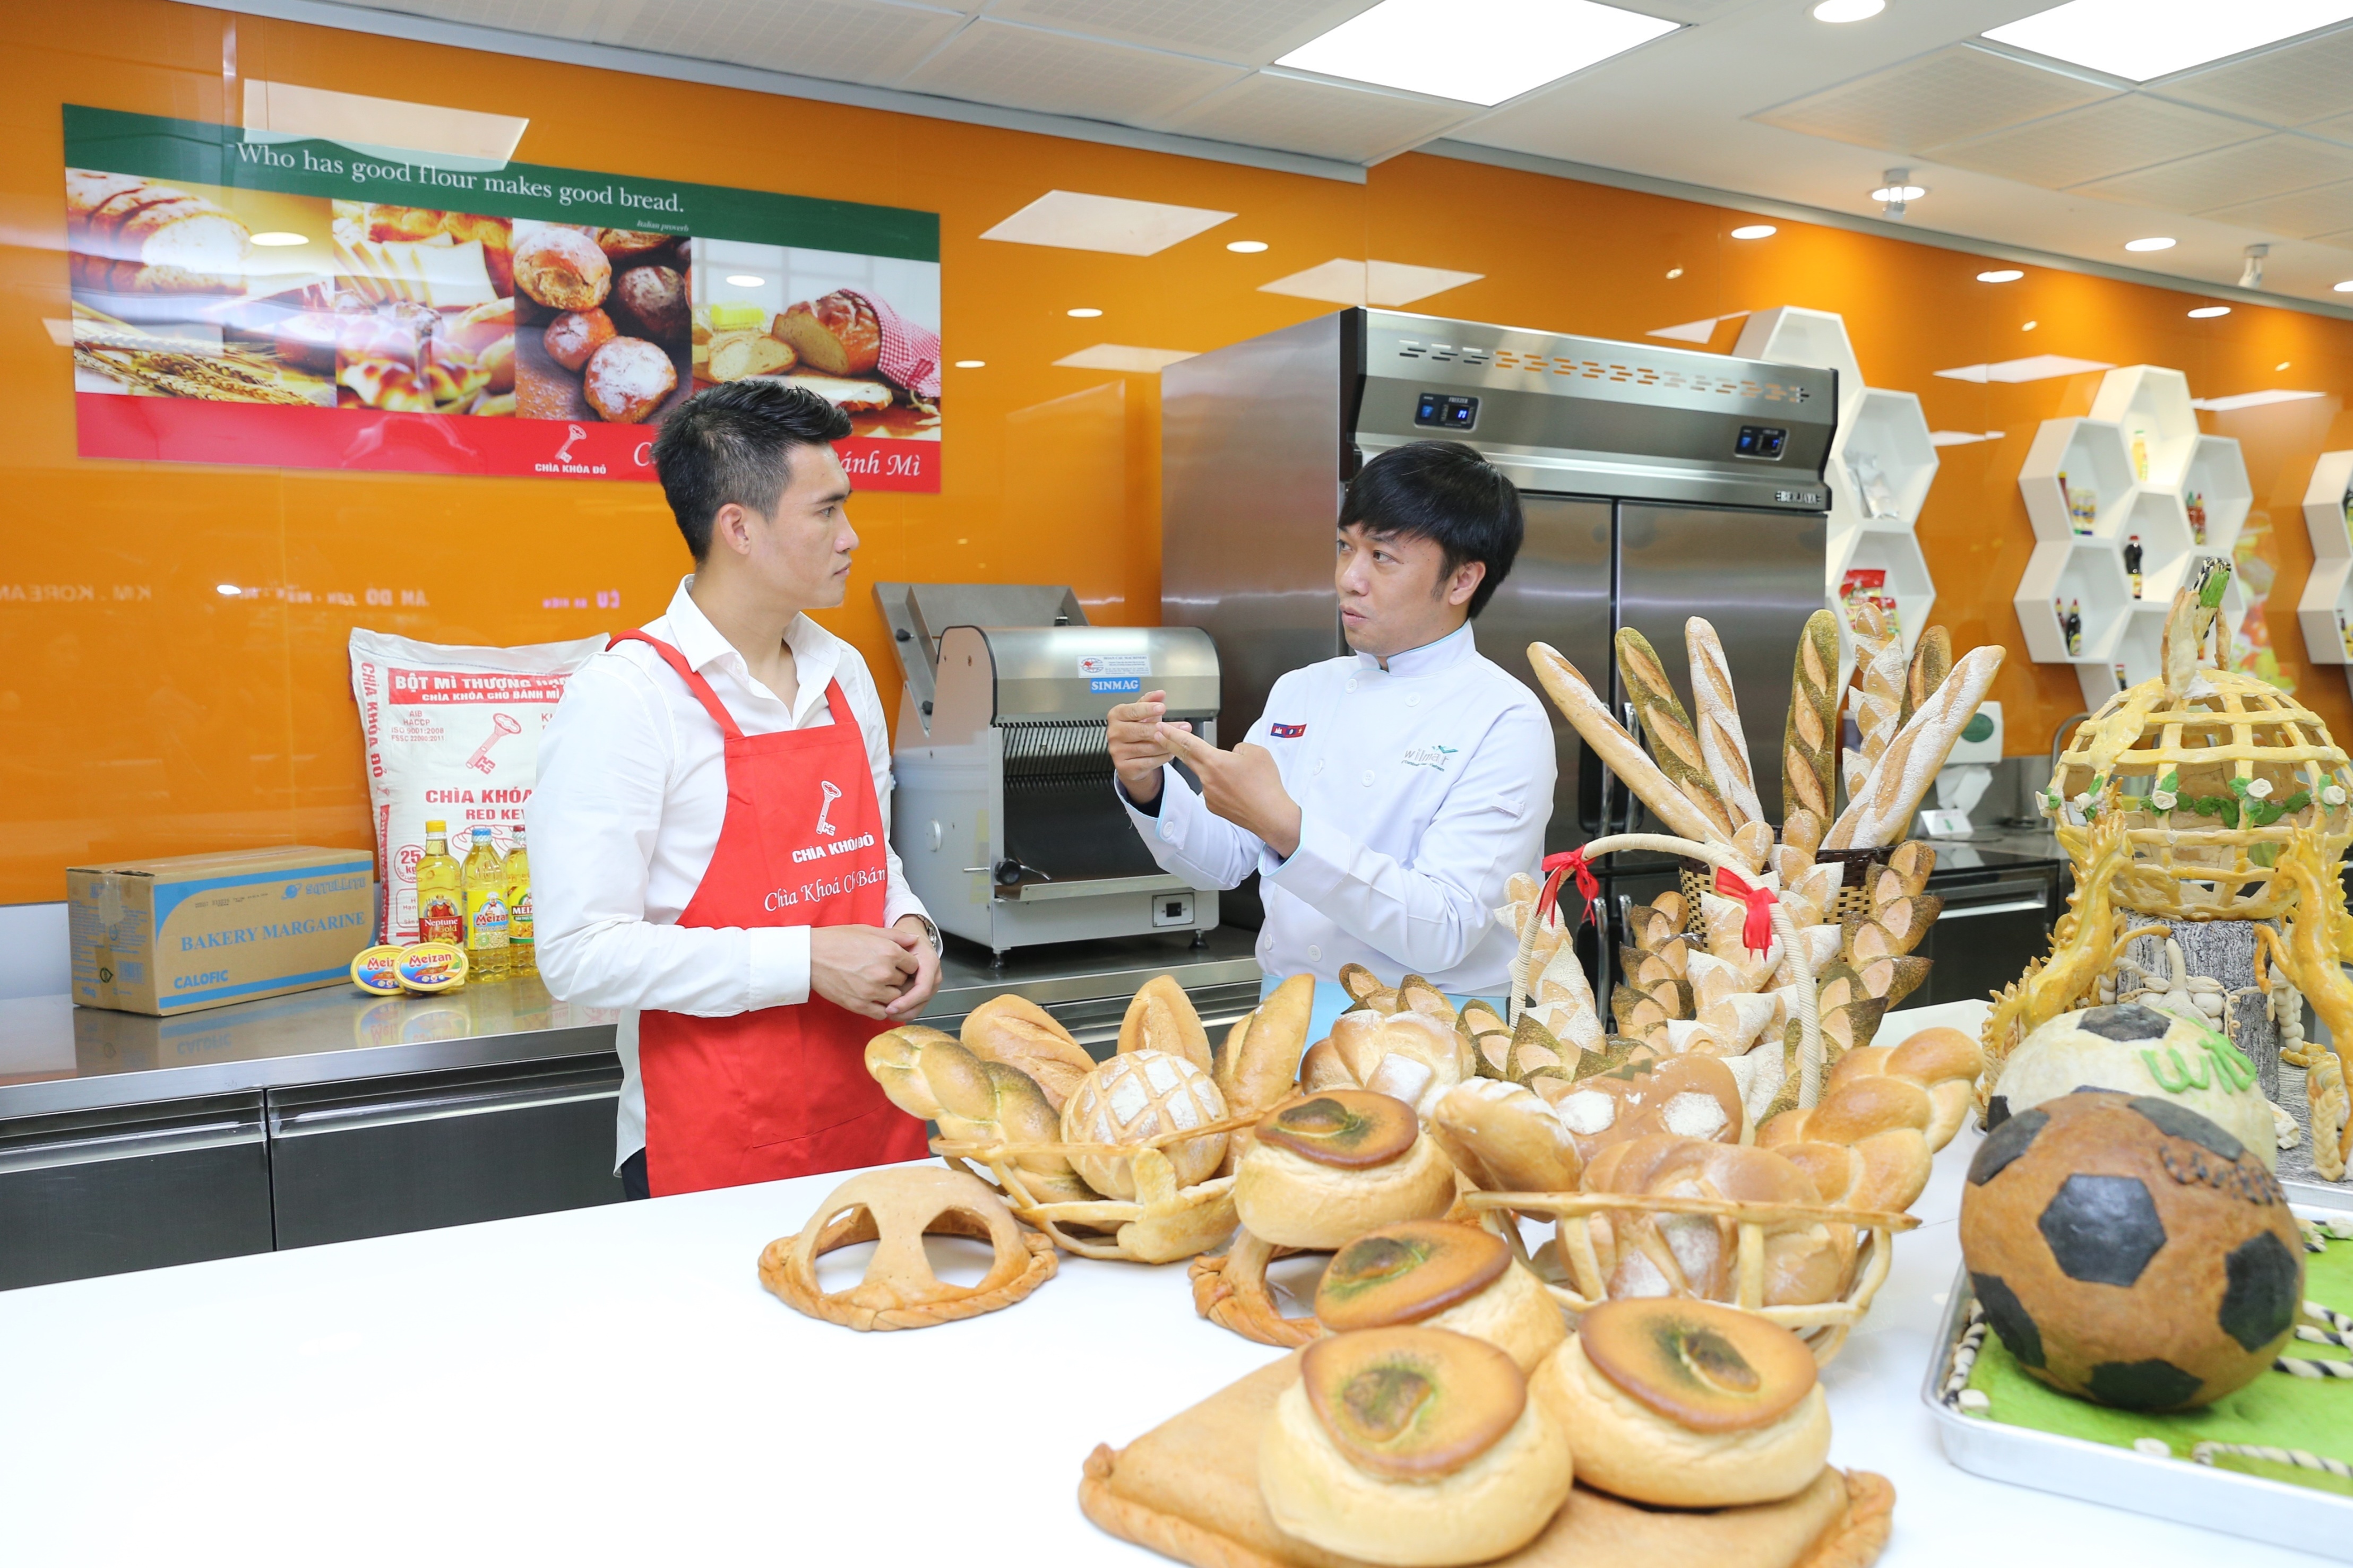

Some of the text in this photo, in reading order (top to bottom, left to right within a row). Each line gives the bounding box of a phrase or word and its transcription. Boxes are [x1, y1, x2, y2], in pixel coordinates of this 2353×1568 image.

[237, 142, 684, 212] Who has good flour makes good bread.
[535, 462, 607, 474] CHÌA KHÓA ĐỎ
[837, 450, 921, 477] ánh Mì
[395, 672, 428, 693] BỘT
[434, 675, 456, 690] MÌ
[461, 678, 531, 691] THƯỢNG
[1091, 680, 1139, 690] SINMAG
[422, 688, 559, 701] CHÌA KHÓA CHO BÁNH MÌ
[1404, 748, 1449, 765] wilmar
[426, 787, 475, 803] CHÌA
[466, 809, 496, 820] RED
[401, 850, 421, 864] 25
[792, 846, 826, 863] CHÌA
[764, 888, 798, 912] Chìa
[800, 877, 840, 902] Khoá
[856, 863, 887, 887] Bán
[425, 919, 458, 927] Neptune
[180, 927, 258, 952] BAKERY
[263, 912, 365, 940] MARGARINE
[367, 957, 394, 971] Meiz
[409, 954, 452, 967] Meizan
[174, 969, 229, 990] CALOFIC
